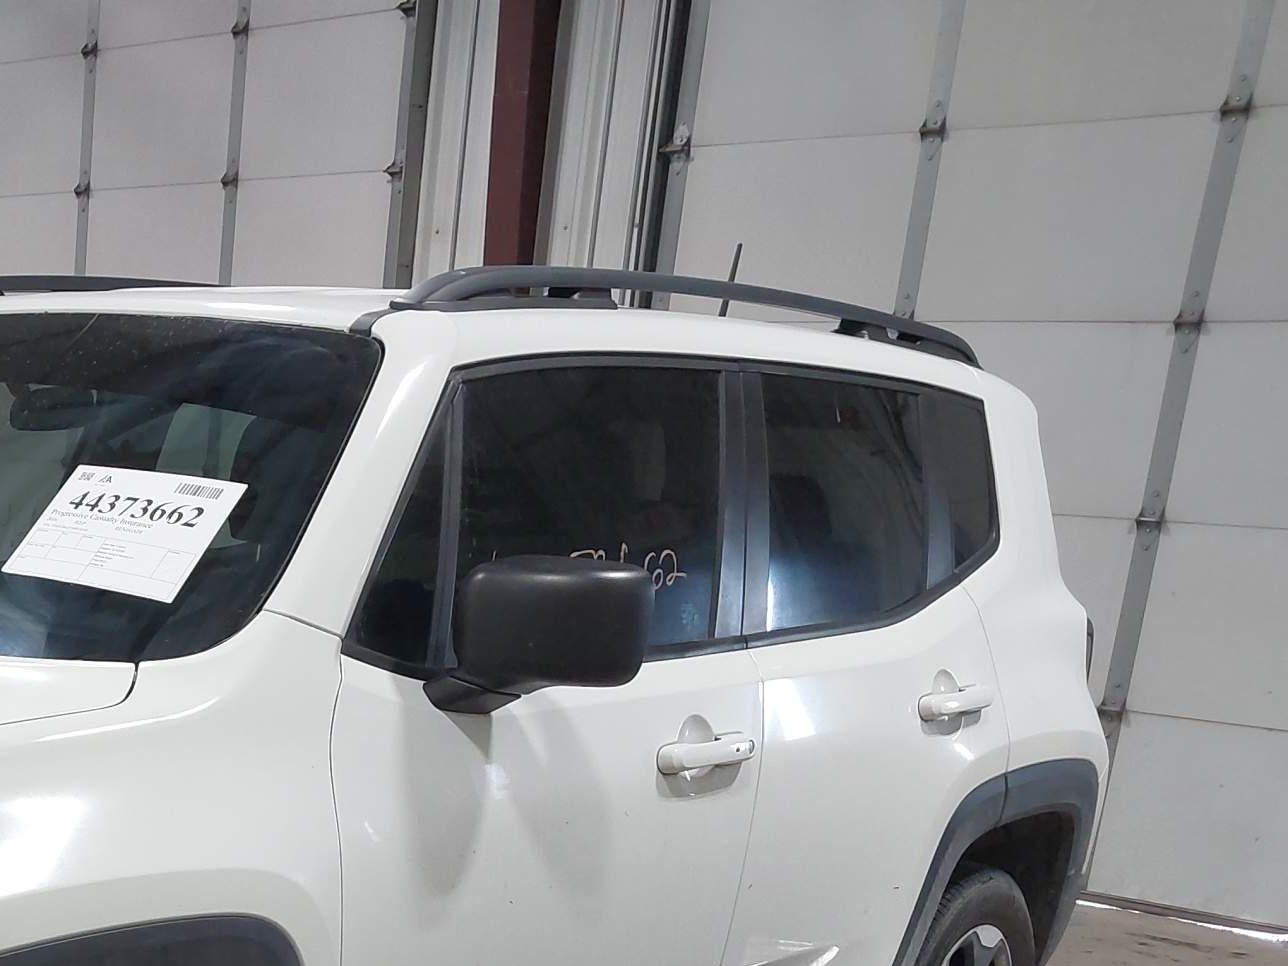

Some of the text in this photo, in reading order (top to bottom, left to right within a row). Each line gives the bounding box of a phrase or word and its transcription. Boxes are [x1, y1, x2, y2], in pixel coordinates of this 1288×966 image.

[51, 509, 89, 520] Progressive
[90, 513, 118, 525] Casualty
[119, 517, 154, 529] Insurance
[69, 490, 206, 528] 44373662
